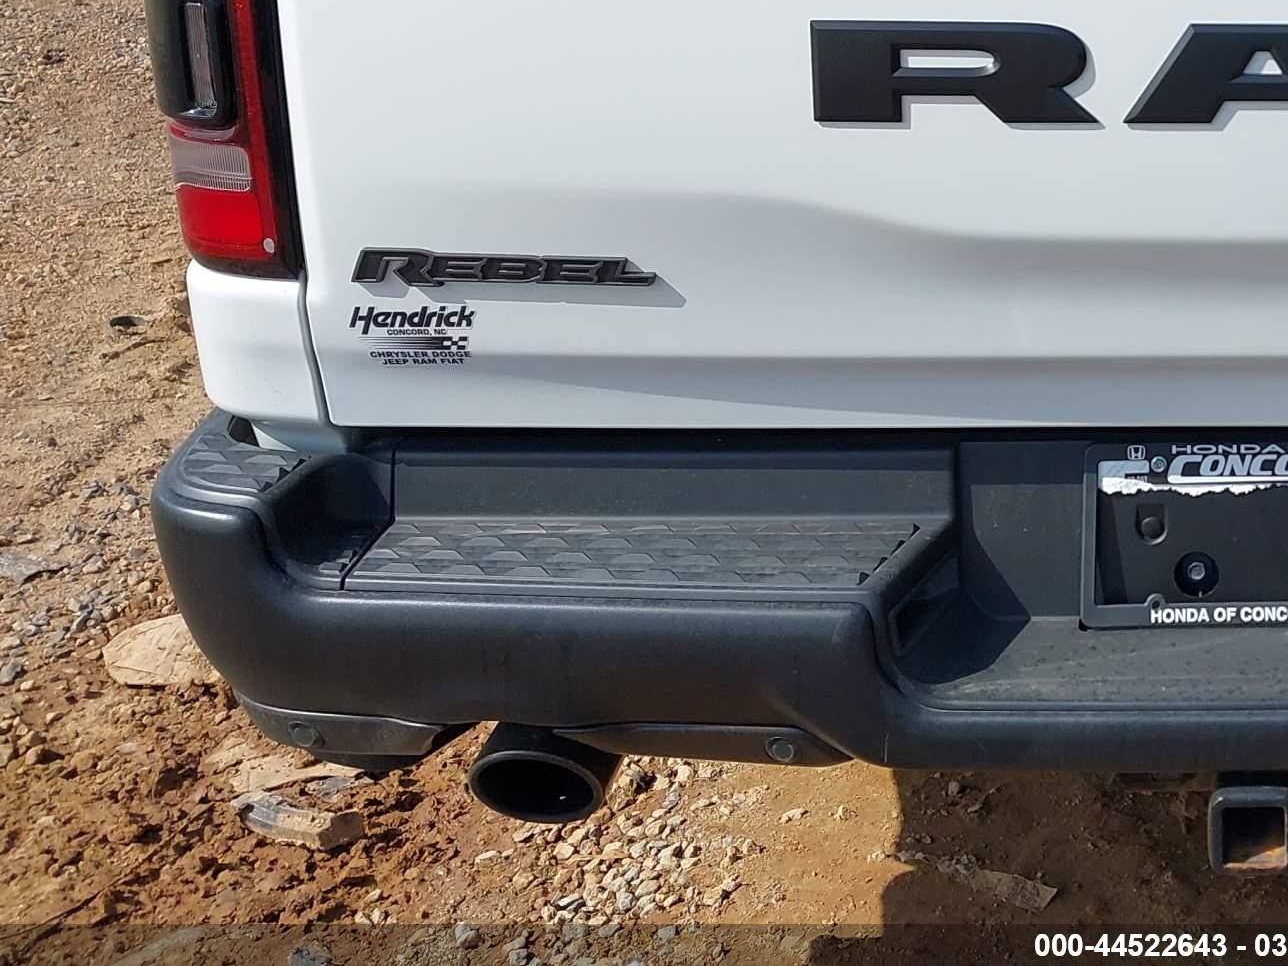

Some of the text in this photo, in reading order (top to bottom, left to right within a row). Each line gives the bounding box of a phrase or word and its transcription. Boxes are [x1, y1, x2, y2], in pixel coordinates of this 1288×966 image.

[350, 247, 657, 287] REBEL
[349, 305, 475, 335] Hendrick
[1172, 445, 1285, 454] HONDA
[1151, 608, 1209, 623] HONDA
[1214, 608, 1237, 622] OF
